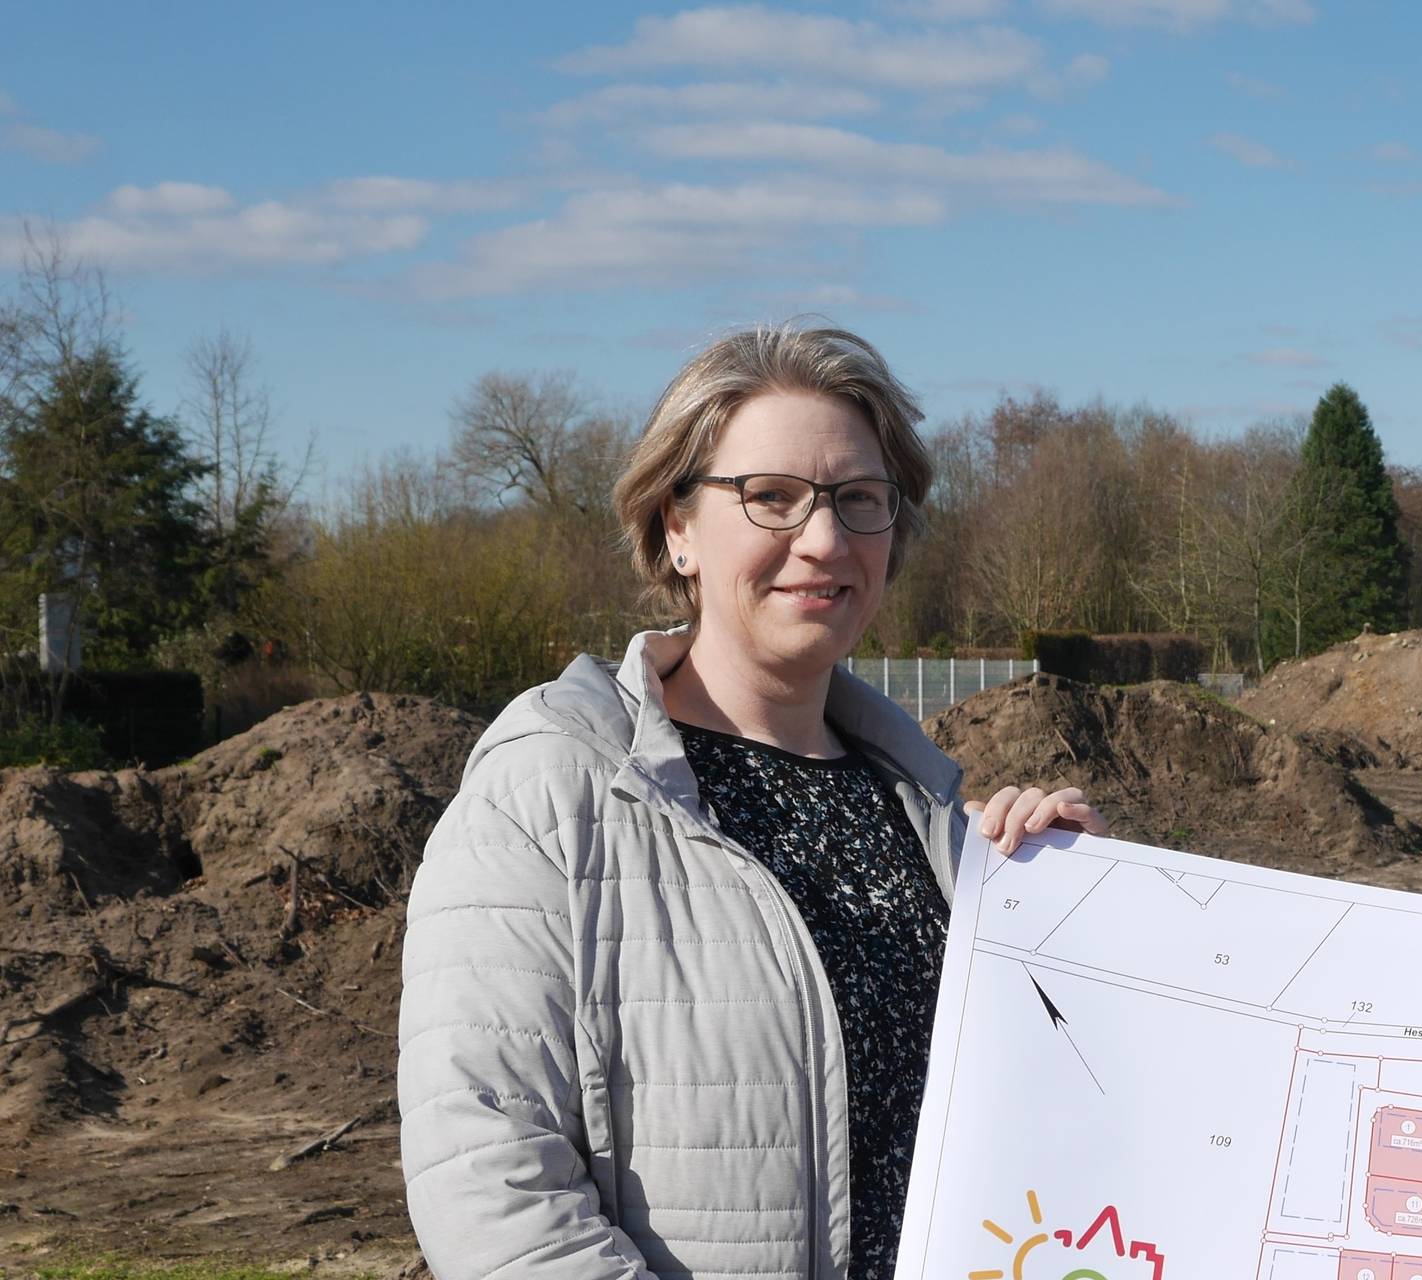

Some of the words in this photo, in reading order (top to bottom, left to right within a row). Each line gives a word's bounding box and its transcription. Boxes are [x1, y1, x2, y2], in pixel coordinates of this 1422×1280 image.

[1004, 899, 1020, 910] 57
[1214, 954, 1229, 965] 53
[1352, 1001, 1372, 1013] 132
[1210, 1135, 1231, 1147] 109
